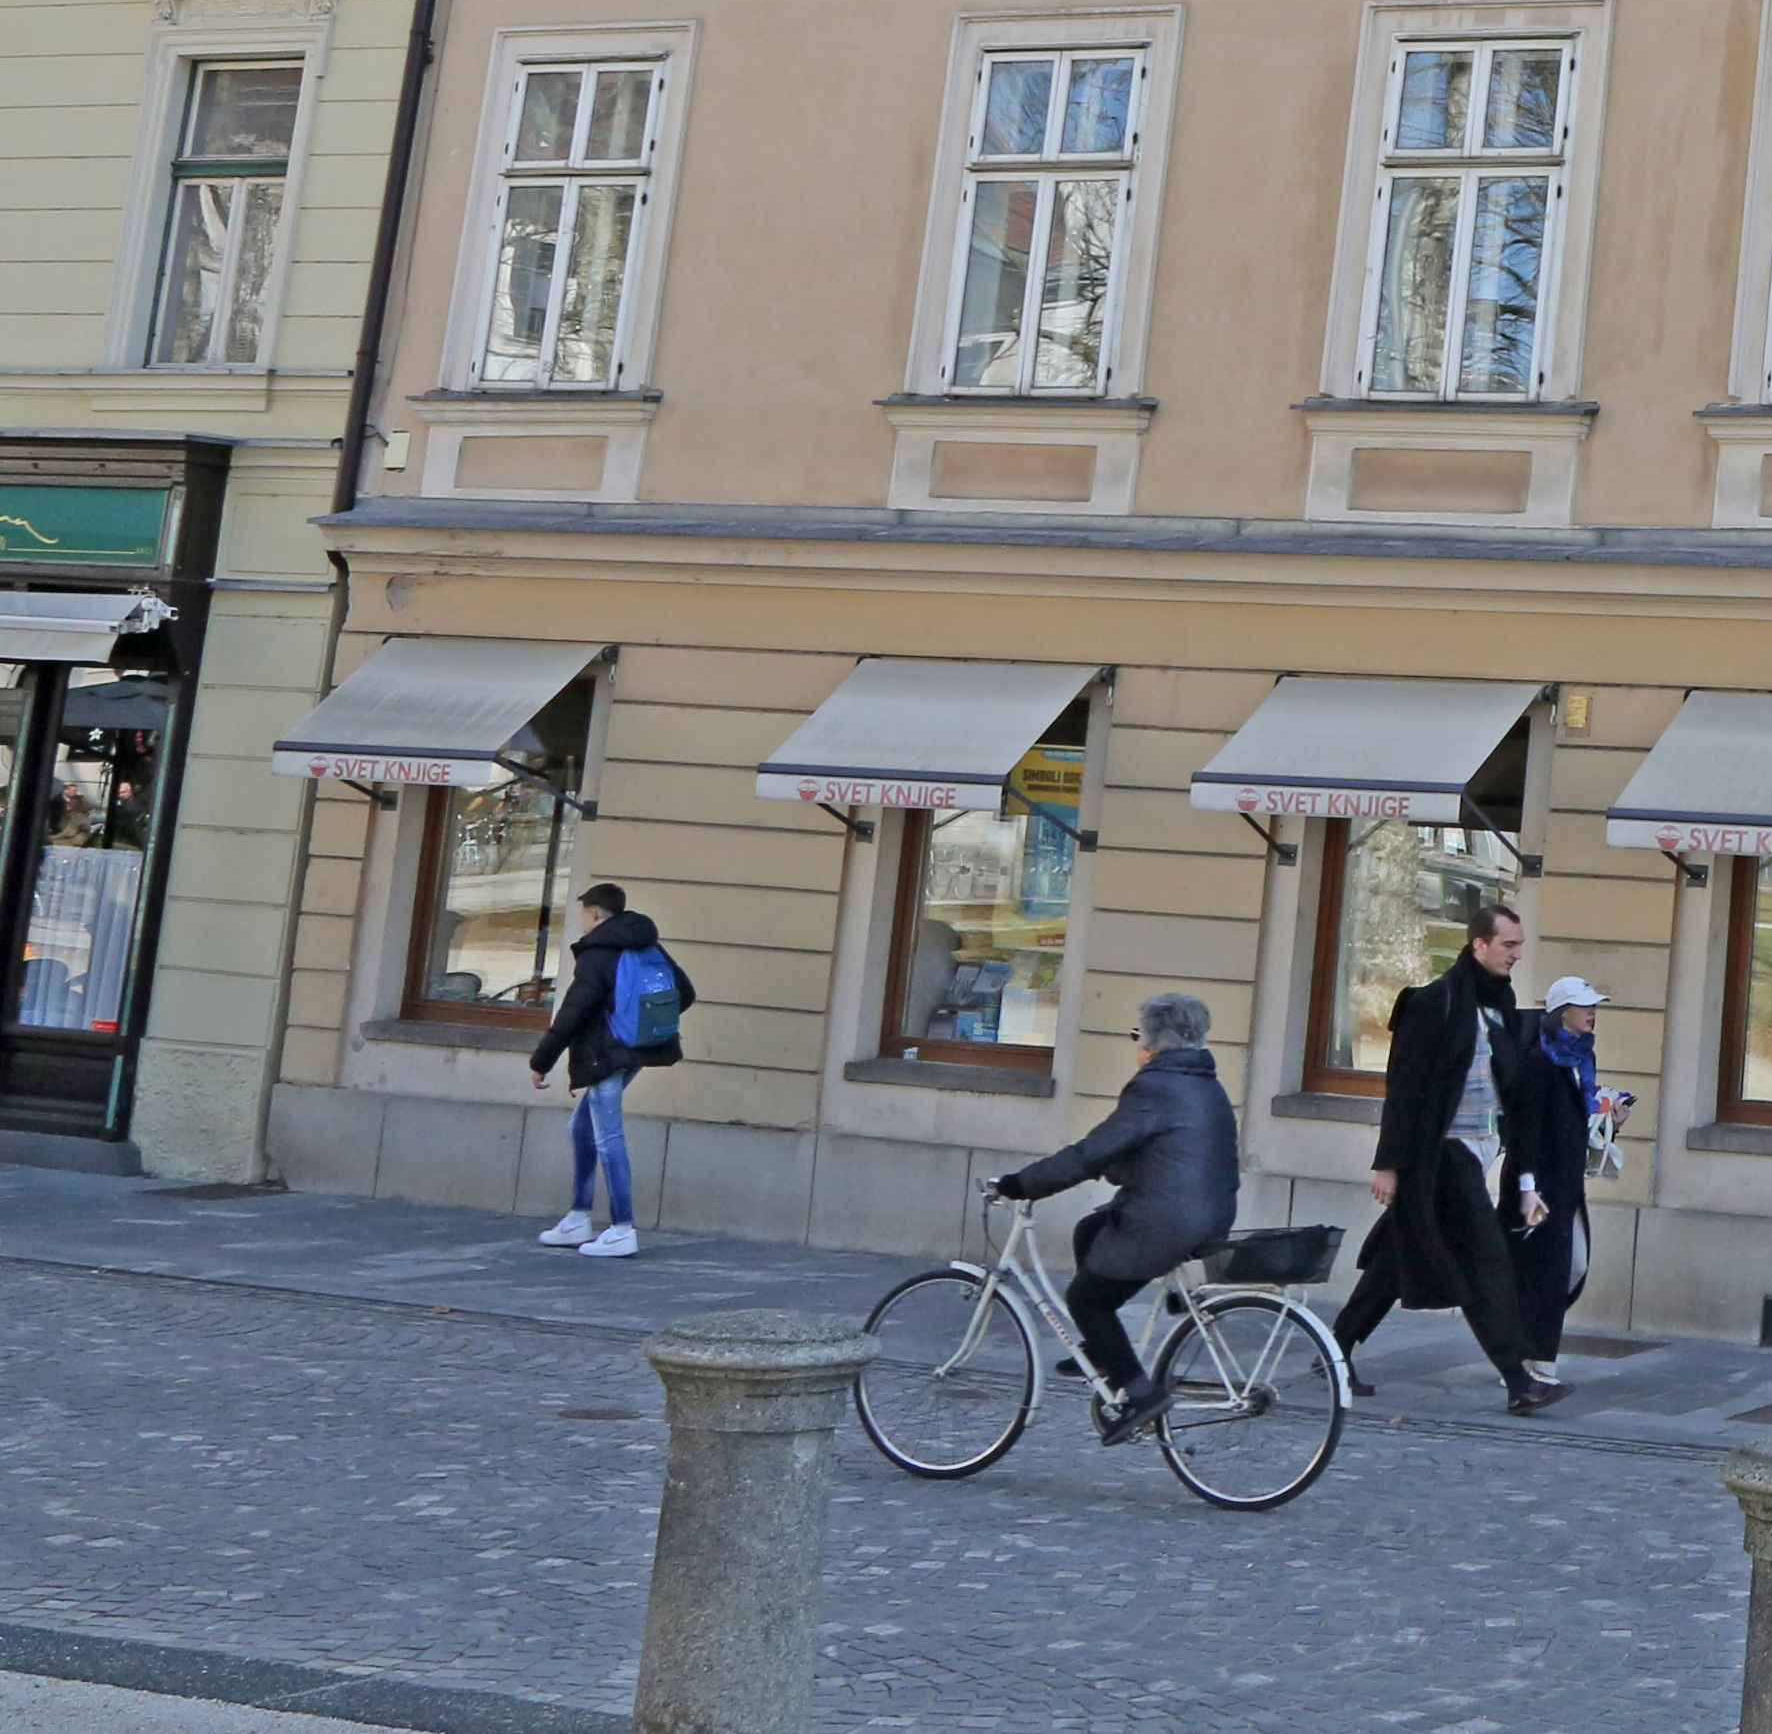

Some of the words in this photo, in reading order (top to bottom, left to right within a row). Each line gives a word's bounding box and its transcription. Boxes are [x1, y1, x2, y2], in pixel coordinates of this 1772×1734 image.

[332, 757, 380, 779] SVET
[383, 761, 452, 784] KNJIGE
[824, 780, 876, 803] SVET
[880, 784, 957, 809] KNJIGE
[1265, 789, 1322, 813] SVET
[1327, 793, 1411, 818] KNJIGE
[1687, 826, 1749, 853] SVET
